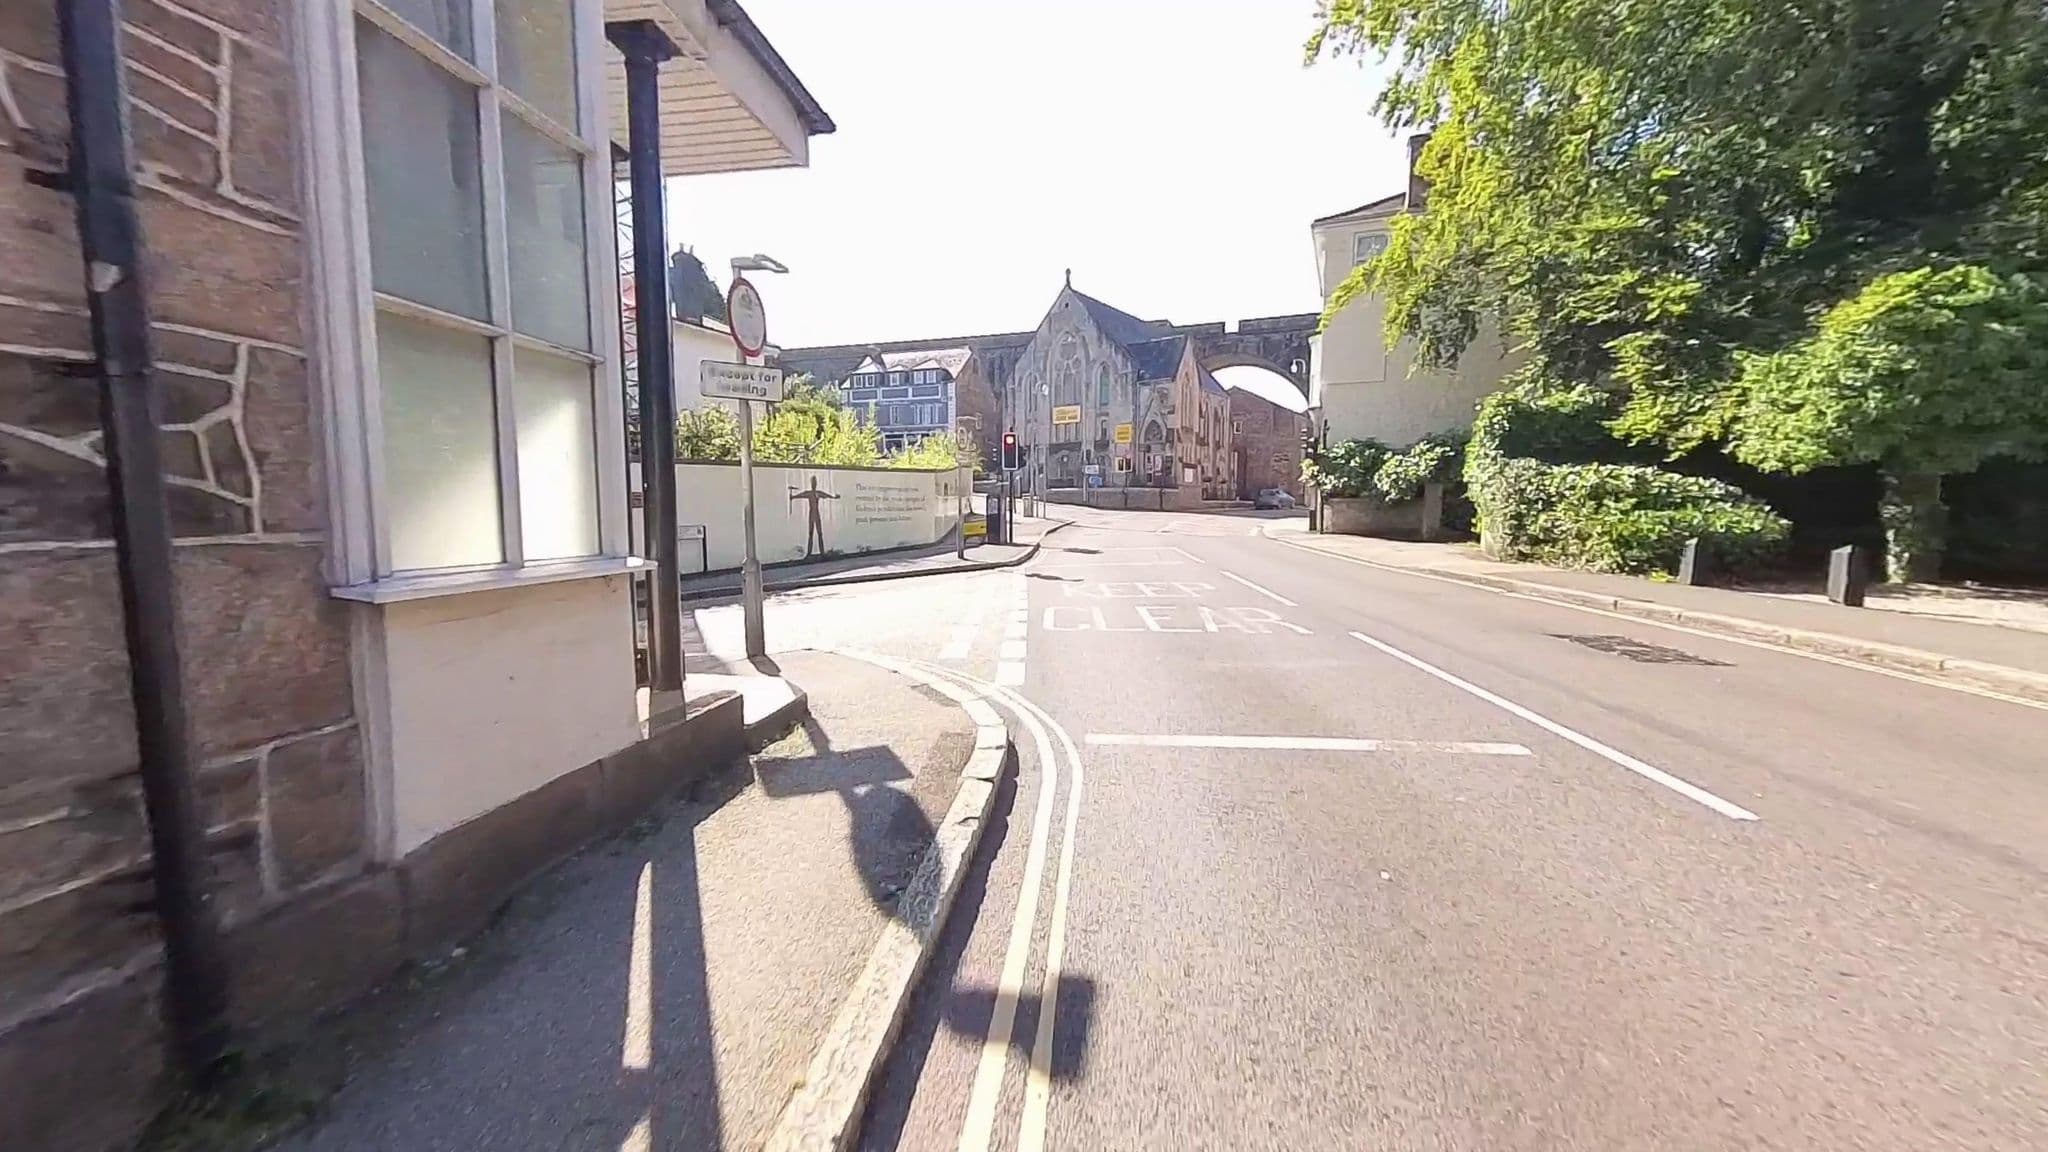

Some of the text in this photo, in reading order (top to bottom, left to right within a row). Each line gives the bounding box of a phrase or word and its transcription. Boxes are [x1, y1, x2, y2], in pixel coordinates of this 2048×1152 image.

[708, 367, 777, 383] cept for
[716, 382, 767, 397] aing
[1061, 582, 1217, 598] KEEP
[1042, 605, 1315, 635] CLEAR
